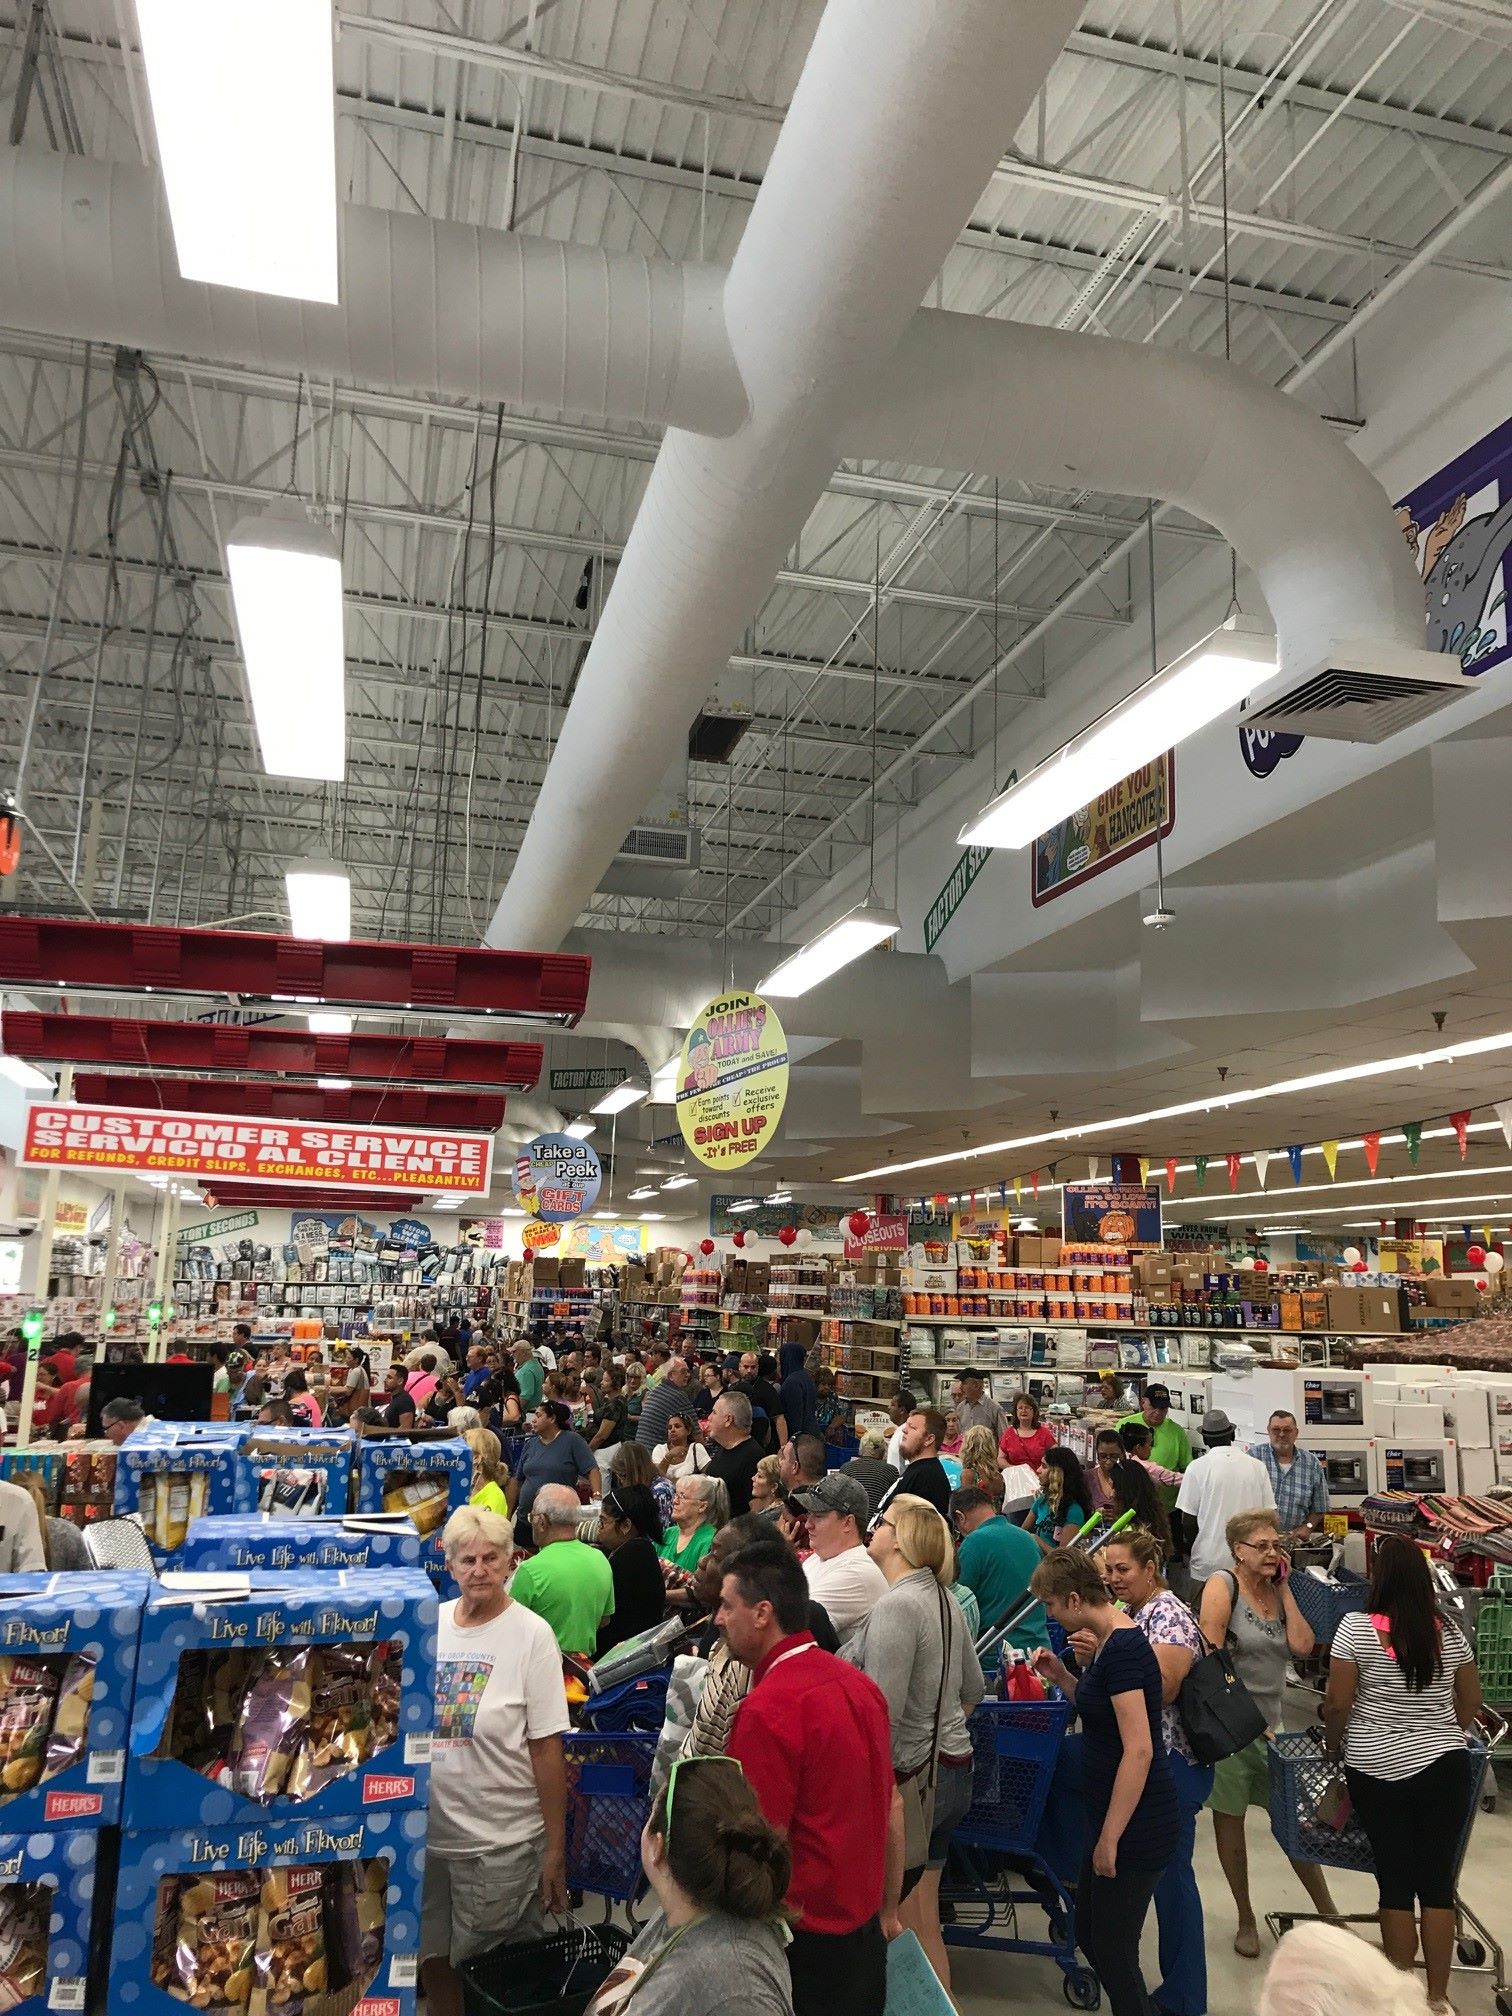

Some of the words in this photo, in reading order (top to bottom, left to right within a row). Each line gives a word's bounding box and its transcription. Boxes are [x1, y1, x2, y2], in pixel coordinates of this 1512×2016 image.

[1098, 781, 1123, 817] GIVE
[1127, 763, 1151, 799] YOU
[928, 857, 968, 947] FACTORY
[706, 996, 750, 1017] JOIN
[707, 1004, 766, 1039] OLLIE'S
[711, 1026, 762, 1060] ARMY
[718, 1058, 741, 1068] TODAY
[742, 1055, 755, 1063] and
[755, 1049, 778, 1060] SAVE!
[553, 1070, 588, 1088] FACTORY
[588, 1068, 626, 1087] SECONDS
[676, 1091, 689, 1100] THE
[747, 1066, 761, 1074] THE
[762, 1056, 787, 1069] PROUD
[697, 1097, 713, 1106] Earn
[713, 1093, 730, 1105] points
[743, 1092, 780, 1106] exclusive
[745, 1085, 776, 1097] Receive
[698, 1110, 730, 1122] discounts
[702, 1103, 723, 1113] toward
[746, 1102, 775, 1113] offers
[35, 1112, 289, 1145] CUSTOMER
[301, 1131, 481, 1159] SERVICE
[694, 1120, 739, 1145] SIGN
[741, 1115, 767, 1135] UP
[33, 1129, 247, 1159] SERVICIO
[256, 1146, 306, 1164] AL
[317, 1150, 481, 1175] CLIENTE
[533, 1144, 573, 1160] Take
[575, 1147, 586, 1159] a
[728, 1138, 757, 1155] FREE!
[30, 1147, 61, 1159] FOR
[66, 1149, 140, 1165] REFUNDS,
[147, 1156, 200, 1169] CREDIT
[205, 1158, 250, 1173] SLIPS,
[258, 1162, 345, 1180] EXCHANGES,
[555, 1160, 598, 1178] Peek
[541, 1187, 586, 1202] GIFT
[716, 1197, 733, 1206] BUY
[542, 1199, 582, 1214] CARDS
[1084, 1200, 1109, 1209] IT'S
[1110, 1200, 1157, 1209] SCARY!
[209, 1212, 256, 1236] SECONDS
[1200, 1224, 1219, 1233] KNOW
[402, 1228, 421, 1239] WE
[848, 1222, 905, 1248] CLOSEOUTS
[1171, 1232, 1214, 1240] WHAT
[152, 1323, 158, 1331] 4
[162, 1322, 168, 1330] 5
[98, 1334, 105, 1343] 3
[29, 1349, 38, 1361] 2
[375, 1454, 394, 1466] Live
[397, 1453, 411, 1468] Life
[429, 1456, 460, 1468] Flavor!
[1387, 1450, 1401, 1458] Oster
[154, 1455, 170, 1472] Life
[236, 1548, 265, 1566] Live
[271, 1544, 295, 1569] Life
[299, 1549, 319, 1565] with
[323, 1546, 369, 1565] Flavor!
[6, 1619, 71, 1646] Flavor!
[211, 1616, 248, 1640] Live
[256, 1610, 286, 1642] Life
[290, 1619, 315, 1636] with
[320, 1609, 378, 1635] Flavor!
[368, 1778, 410, 1795] HERR'S
[51, 1797, 96, 1813] HERR'S
[191, 1838, 229, 1863] Live
[237, 1829, 268, 1864] Life
[273, 1839, 299, 1856] with
[304, 1824, 365, 1855] Flavor!
[290, 1871, 322, 1889] HERR
[353, 2002, 394, 2016] HERR'S
